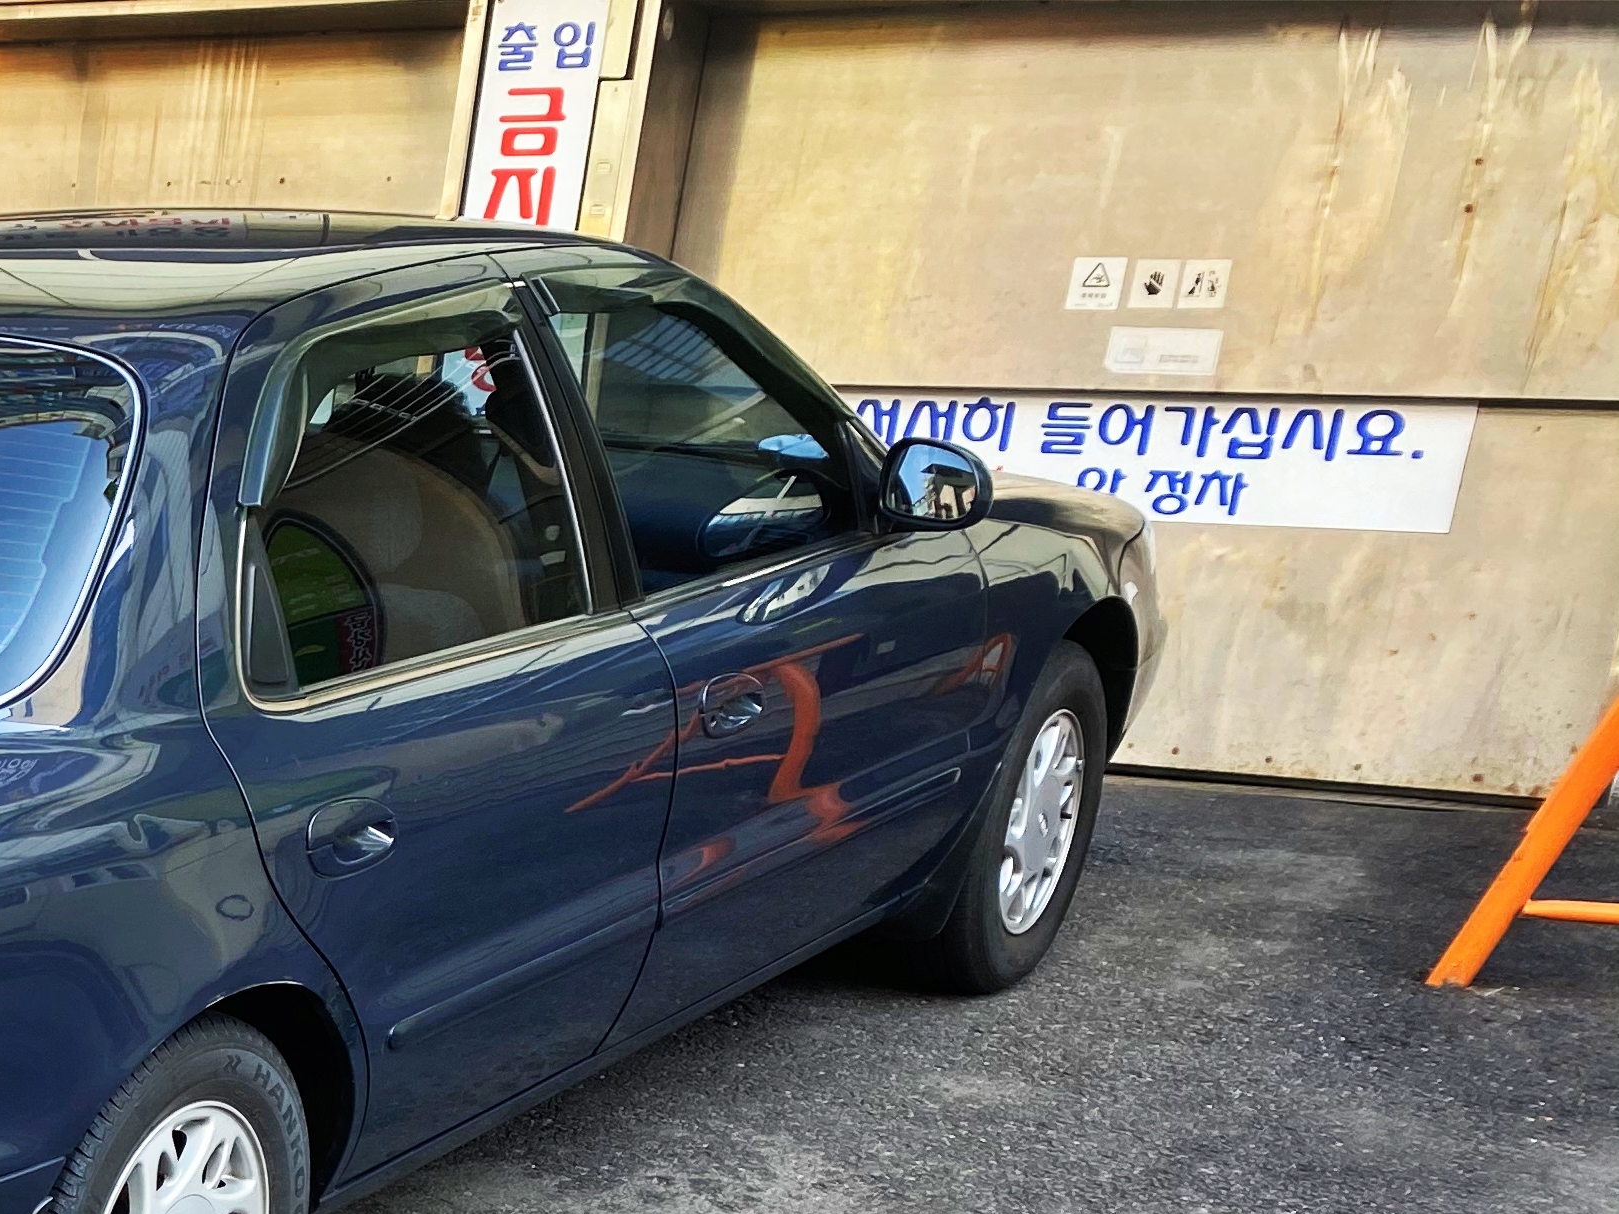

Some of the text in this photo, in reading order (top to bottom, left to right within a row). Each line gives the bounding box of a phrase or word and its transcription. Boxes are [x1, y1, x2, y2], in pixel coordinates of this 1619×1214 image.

[498, 21, 596, 71] 출입
[483, 87, 566, 226] 금지
[1041, 402, 1424, 462] 들어가십시요.
[1145, 470, 1248, 516] 정차
